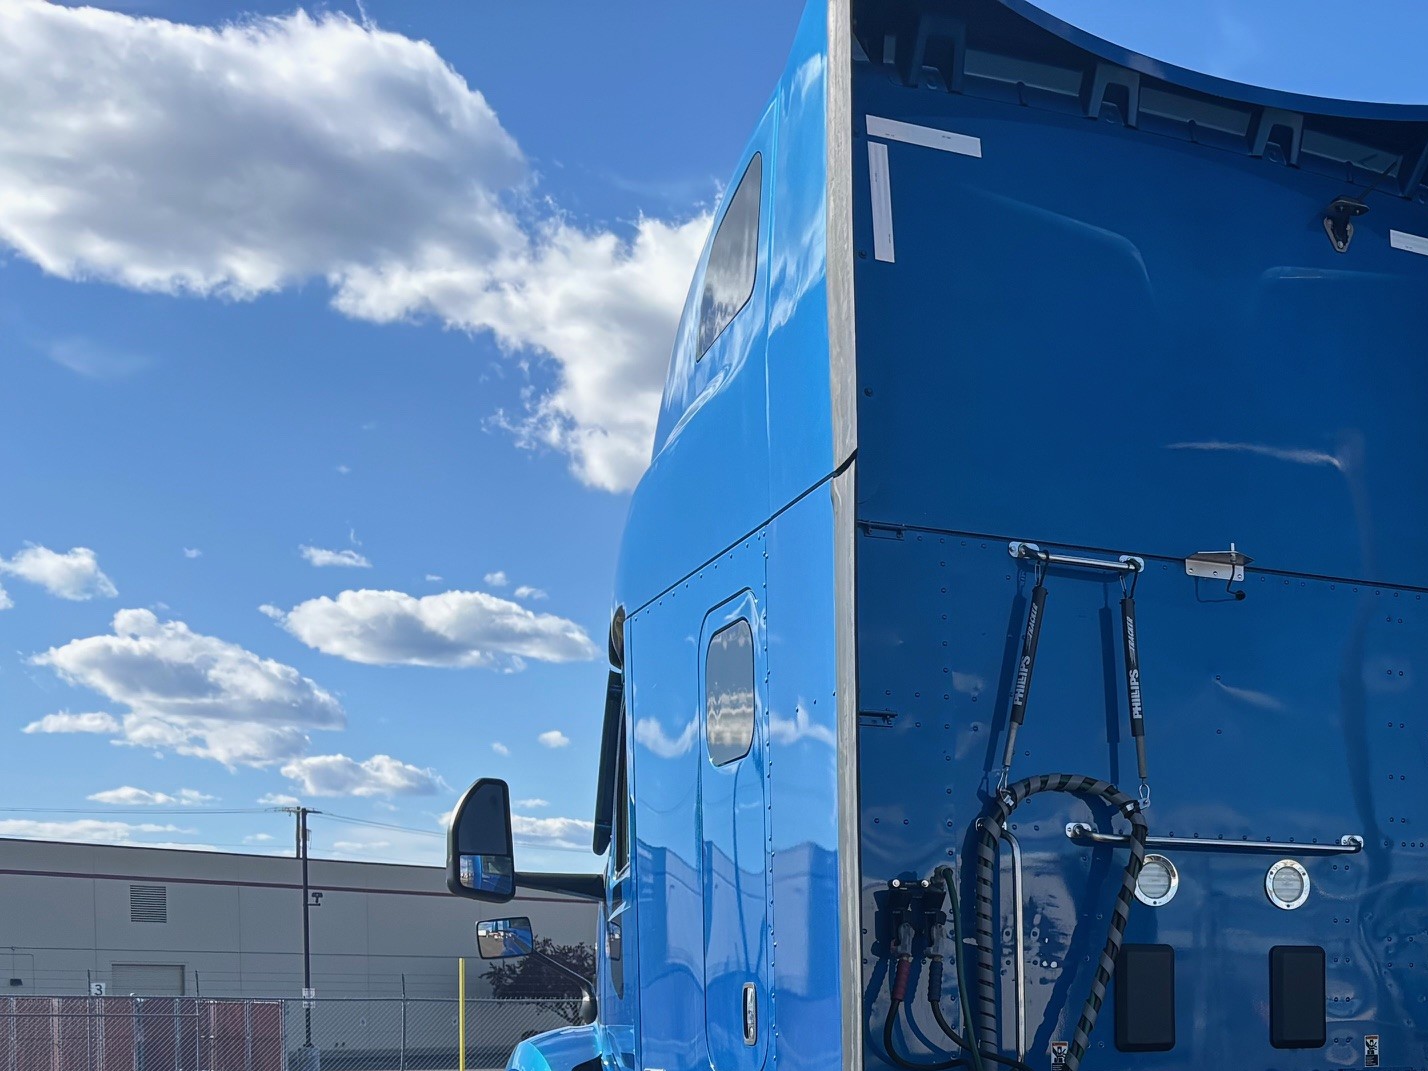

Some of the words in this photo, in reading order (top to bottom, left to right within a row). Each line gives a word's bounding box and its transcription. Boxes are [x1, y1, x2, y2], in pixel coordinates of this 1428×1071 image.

[1013, 655, 1031, 706] PHILLIPS
[1129, 668, 1142, 720] PHILLIPS
[94, 984, 103, 996] 3
